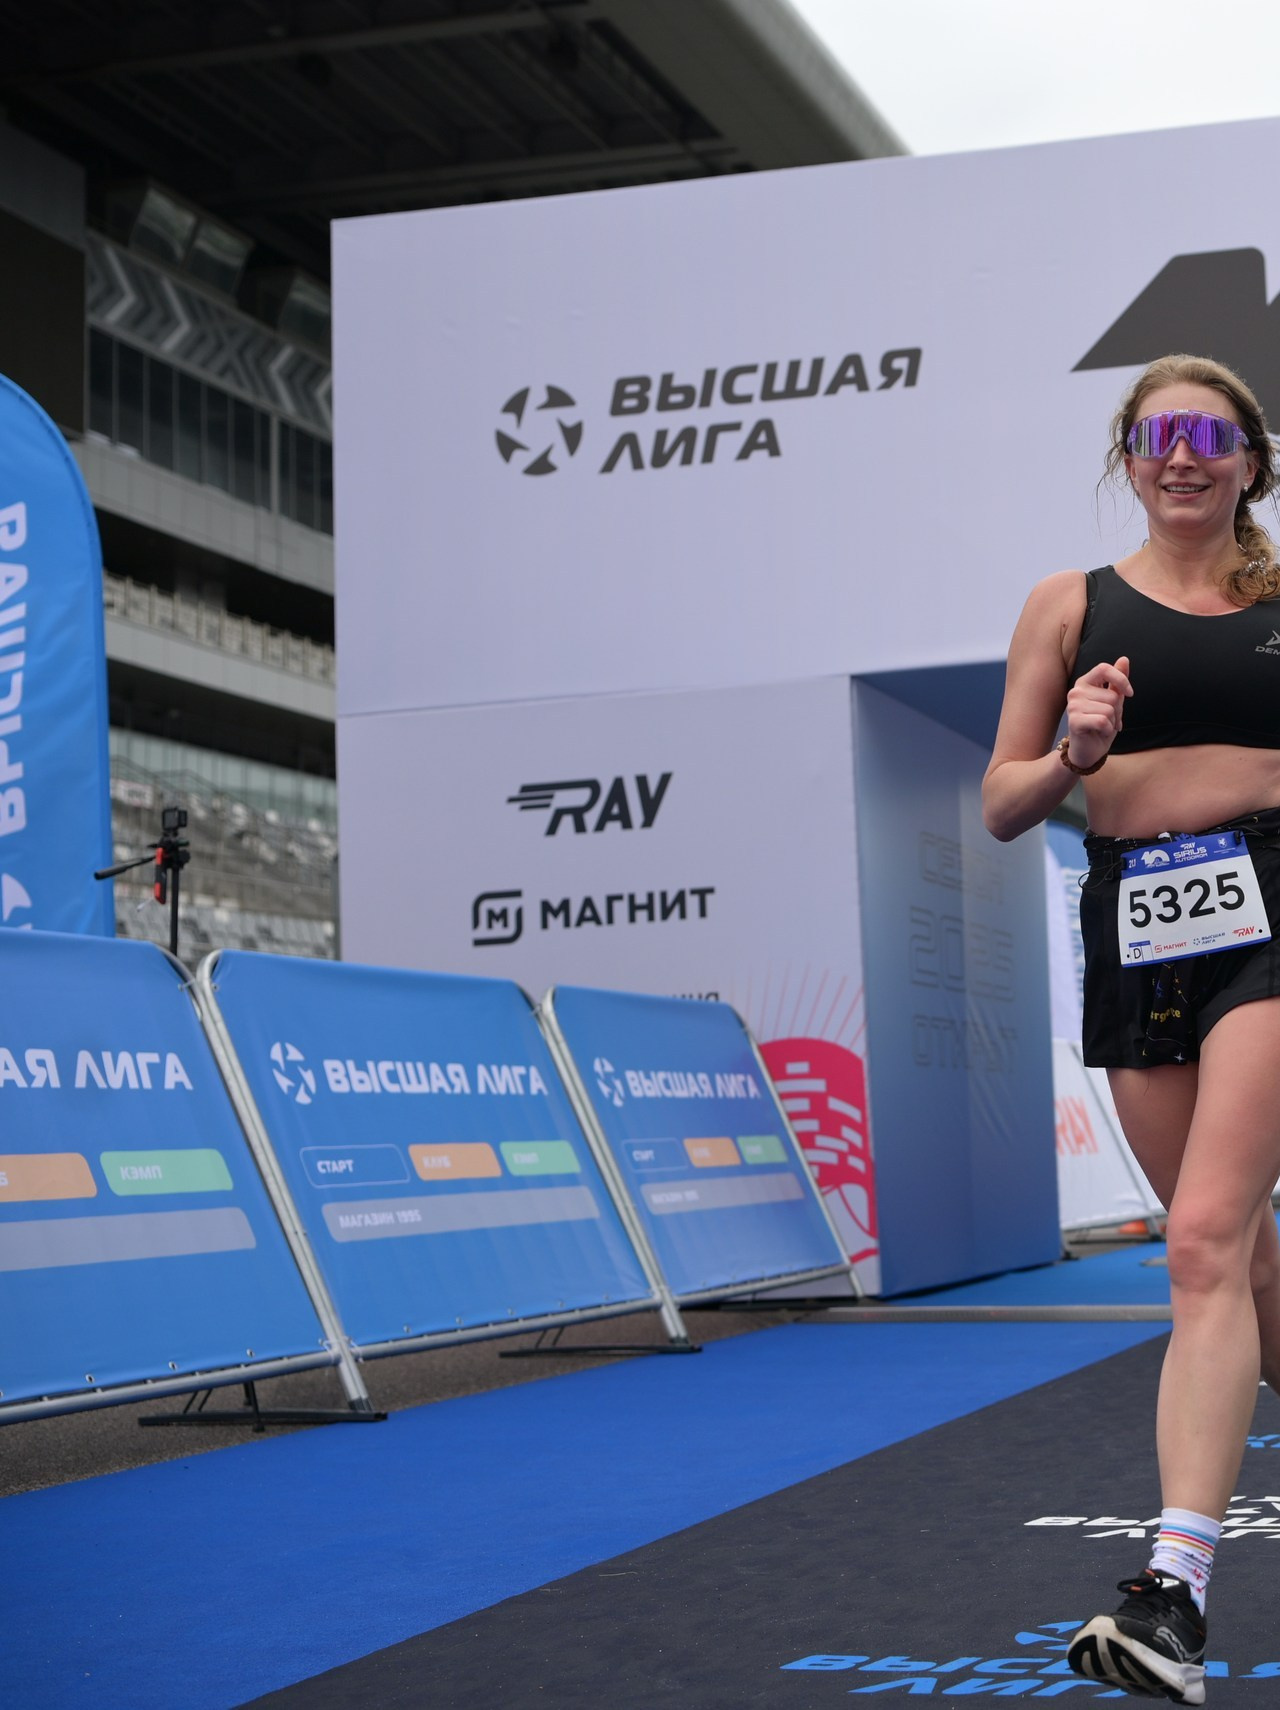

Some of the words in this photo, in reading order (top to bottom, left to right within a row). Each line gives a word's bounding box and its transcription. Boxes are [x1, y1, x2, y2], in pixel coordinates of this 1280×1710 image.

[610, 347, 922, 417] ВЫСШАЯ
[598, 418, 782, 474] ЛИГА
[506, 772, 673, 837] RAY
[1173, 846, 1207, 859] SIRIUS
[1179, 841, 1196, 851] RAY
[540, 887, 715, 930] МАГНИТ
[1129, 871, 1245, 928] 5325
[1163, 941, 1187, 951] МАГНИТ
[1231, 926, 1255, 938] RAY
[74, 1050, 194, 1090] ЛИГА
[322, 1059, 470, 1095] ВЫСШАЯ
[476, 1063, 548, 1096] ЛИГА
[625, 1070, 714, 1099] ВЫСШАЯ
[715, 1073, 762, 1099] ЛИГА
[120, 1165, 162, 1181] КЭМП
[317, 1158, 354, 1174] СТАРТ
[339, 1211, 395, 1228] МАГАЗИН
